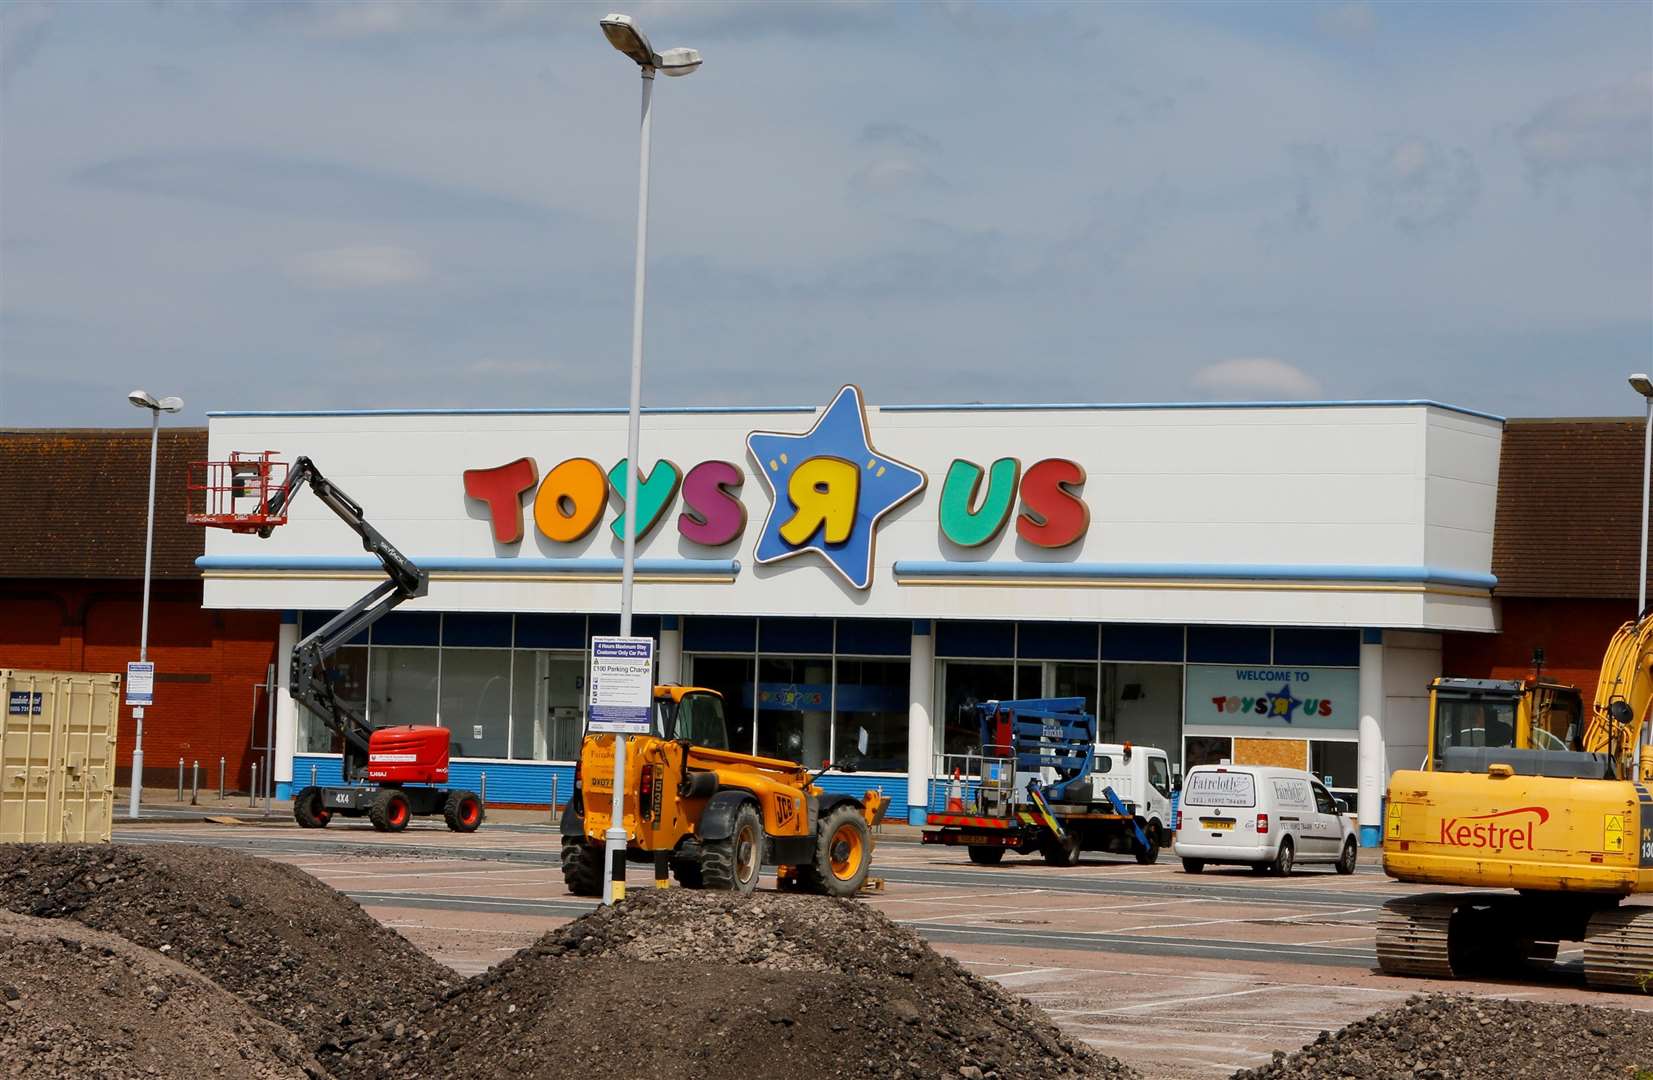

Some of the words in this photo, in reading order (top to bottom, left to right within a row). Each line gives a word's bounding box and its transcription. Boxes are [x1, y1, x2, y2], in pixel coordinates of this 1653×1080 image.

[463, 456, 748, 546] TOYS
[938, 457, 1091, 548] US
[630, 666, 650, 674] Charge
[1236, 670, 1291, 681] WELCOME
[1294, 671, 1310, 682] TO
[1212, 696, 1268, 715] TOYS
[1303, 698, 1332, 716] US
[1193, 776, 1237, 790] Faircloth
[776, 795, 793, 824] JCB
[1441, 818, 1534, 851] Kestrel
